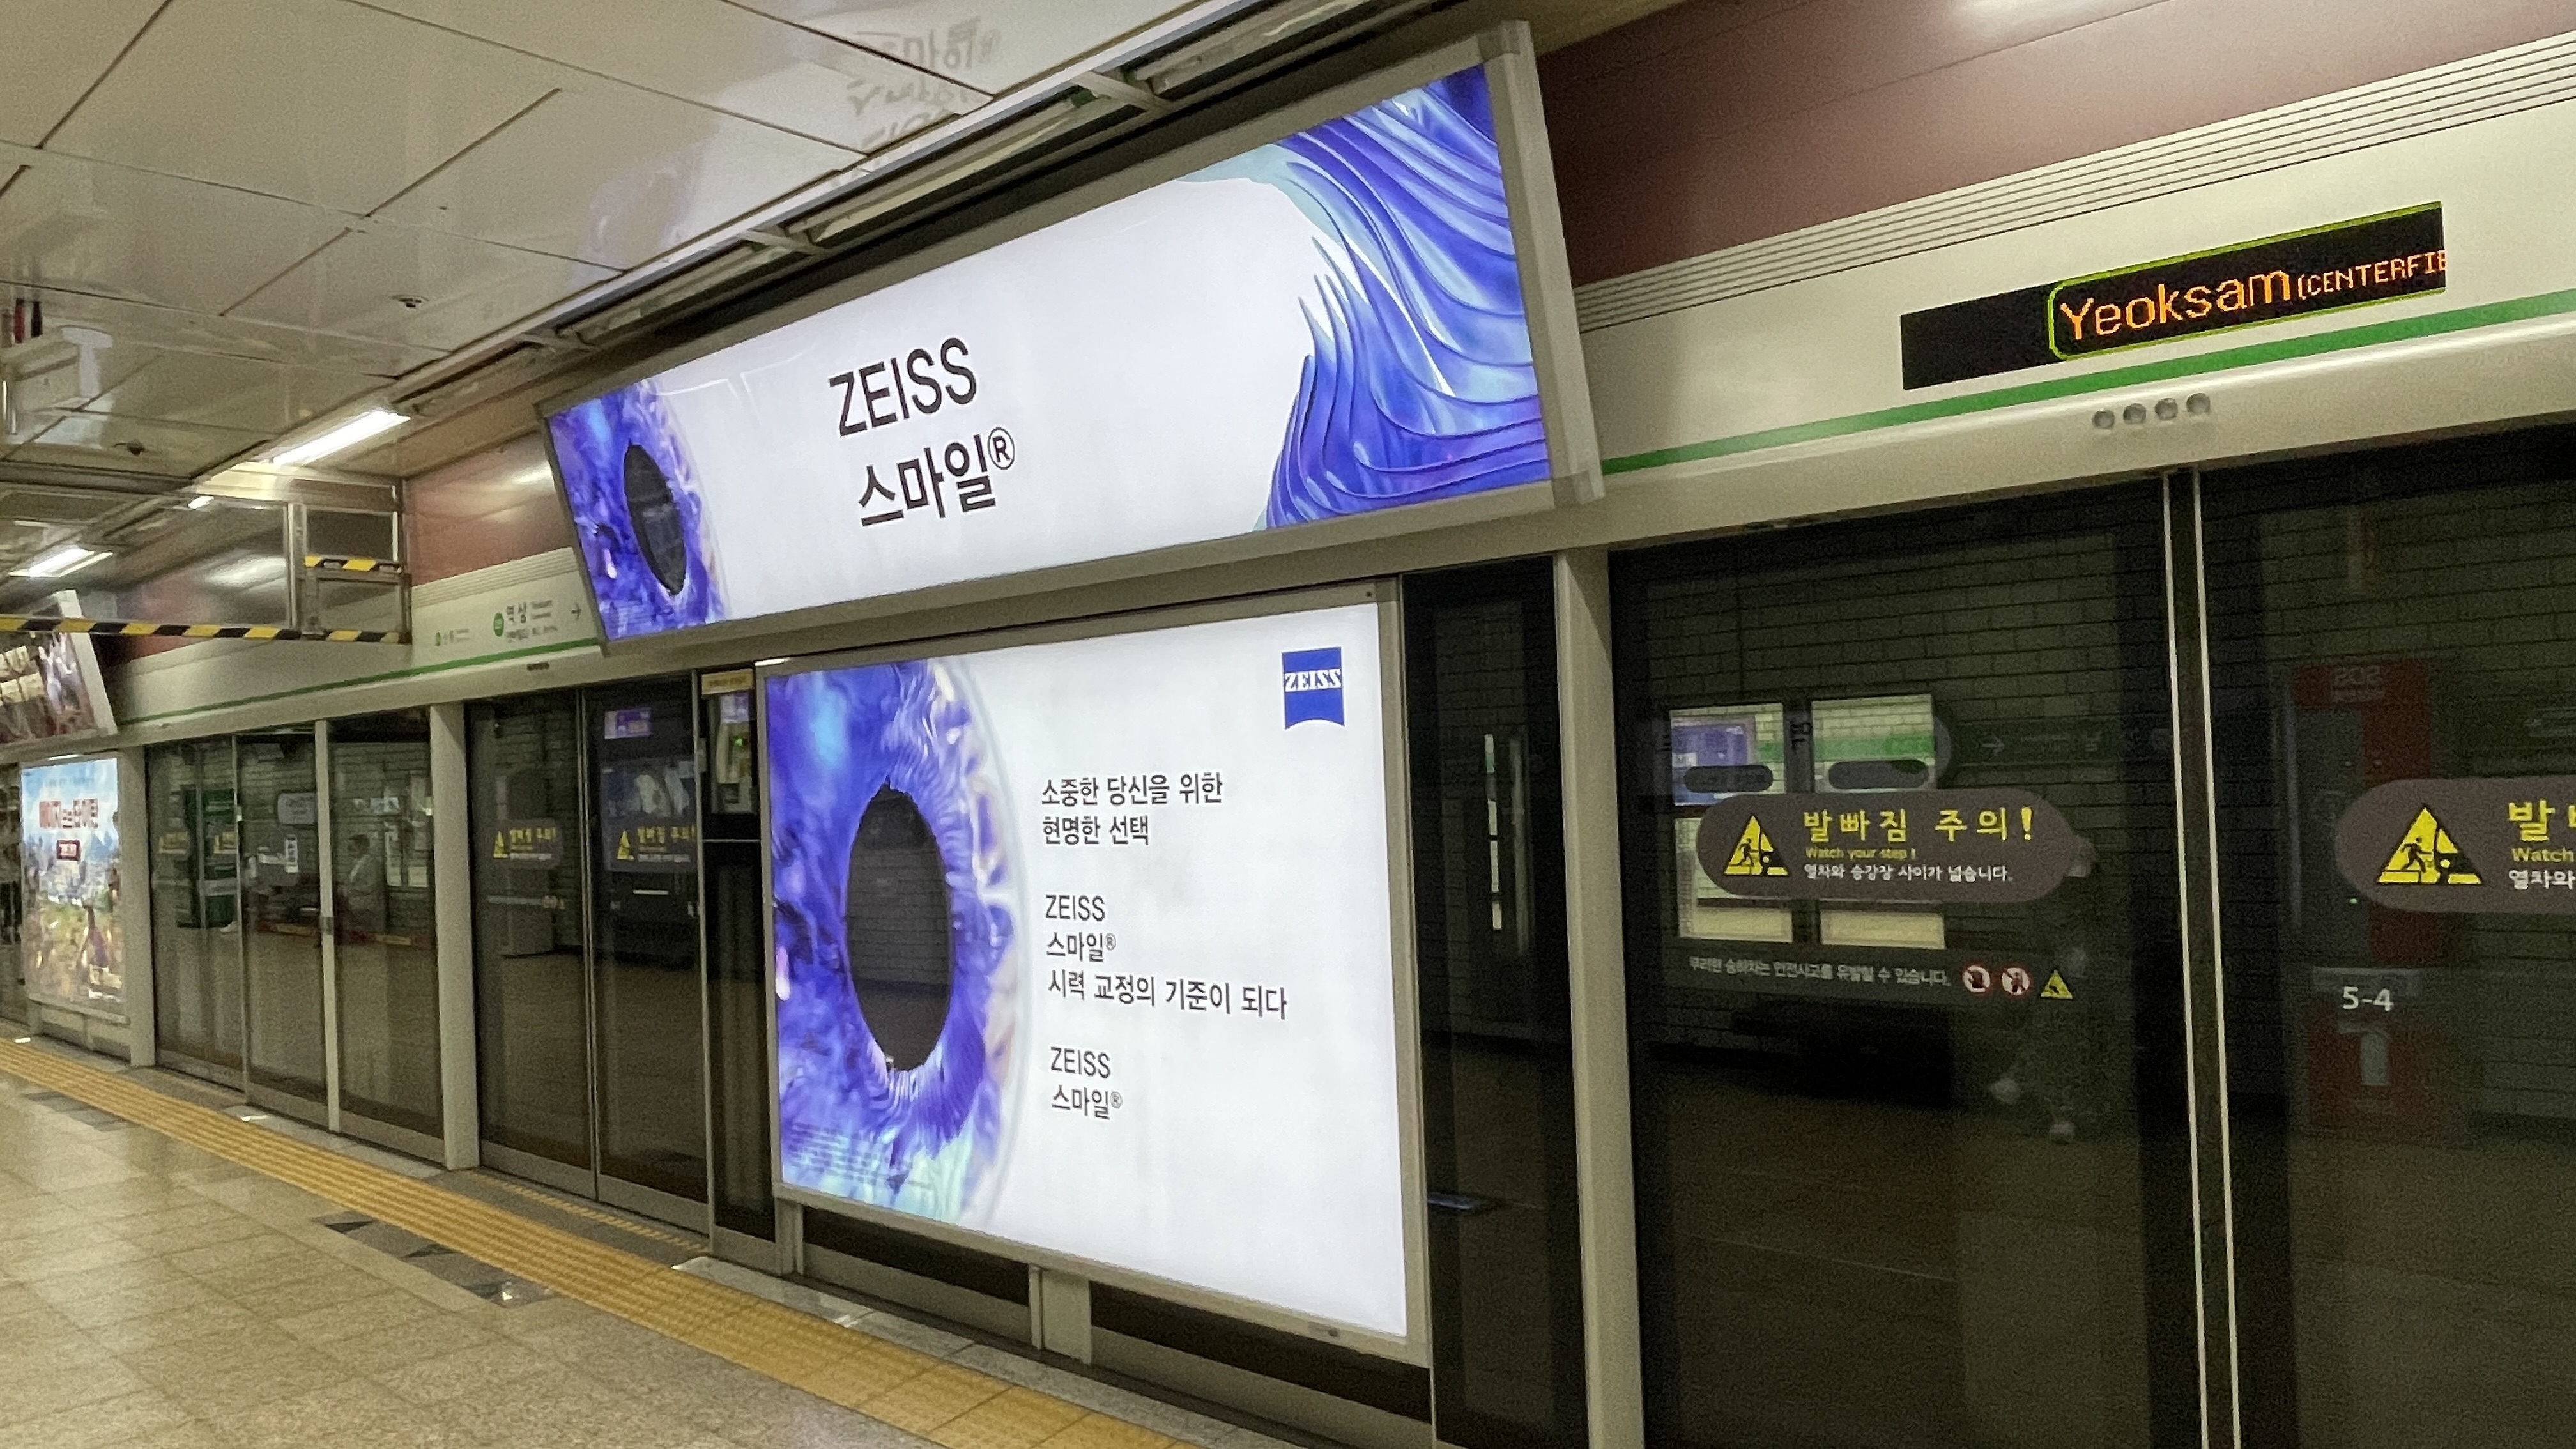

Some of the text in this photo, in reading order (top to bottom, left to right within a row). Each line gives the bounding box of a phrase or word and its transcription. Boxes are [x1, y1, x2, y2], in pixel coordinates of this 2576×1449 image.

[829, 337, 976, 437] ZEISS
[859, 427, 1015, 526] 스마일®
[1284, 668, 1341, 693] ZEISS
[1041, 772, 1223, 807] 소중한 당신을 위한
[1042, 815, 1149, 846] 현명한 선택
[1805, 848, 1844, 859] Watch
[1848, 850, 1877, 861] your
[2511, 847, 2575, 862] Watch
[1804, 864, 1845, 880] 열차와
[1850, 865, 1894, 881] 승강장
[1898, 864, 1943, 882] 사이가
[2508, 869, 2576, 890] 열차와
[1045, 894, 1105, 921] ZEISS
[1046, 931, 1117, 962] 스마일®
[1877, 967, 1892, 983] 수
[1048, 969, 1288, 1021] 시력 교정의 기준이 되다
[2342, 986, 2395, 1011] 5-4
[1050, 1046, 1111, 1078] ZEISS
[1052, 1084, 1123, 1119] 스마일®
